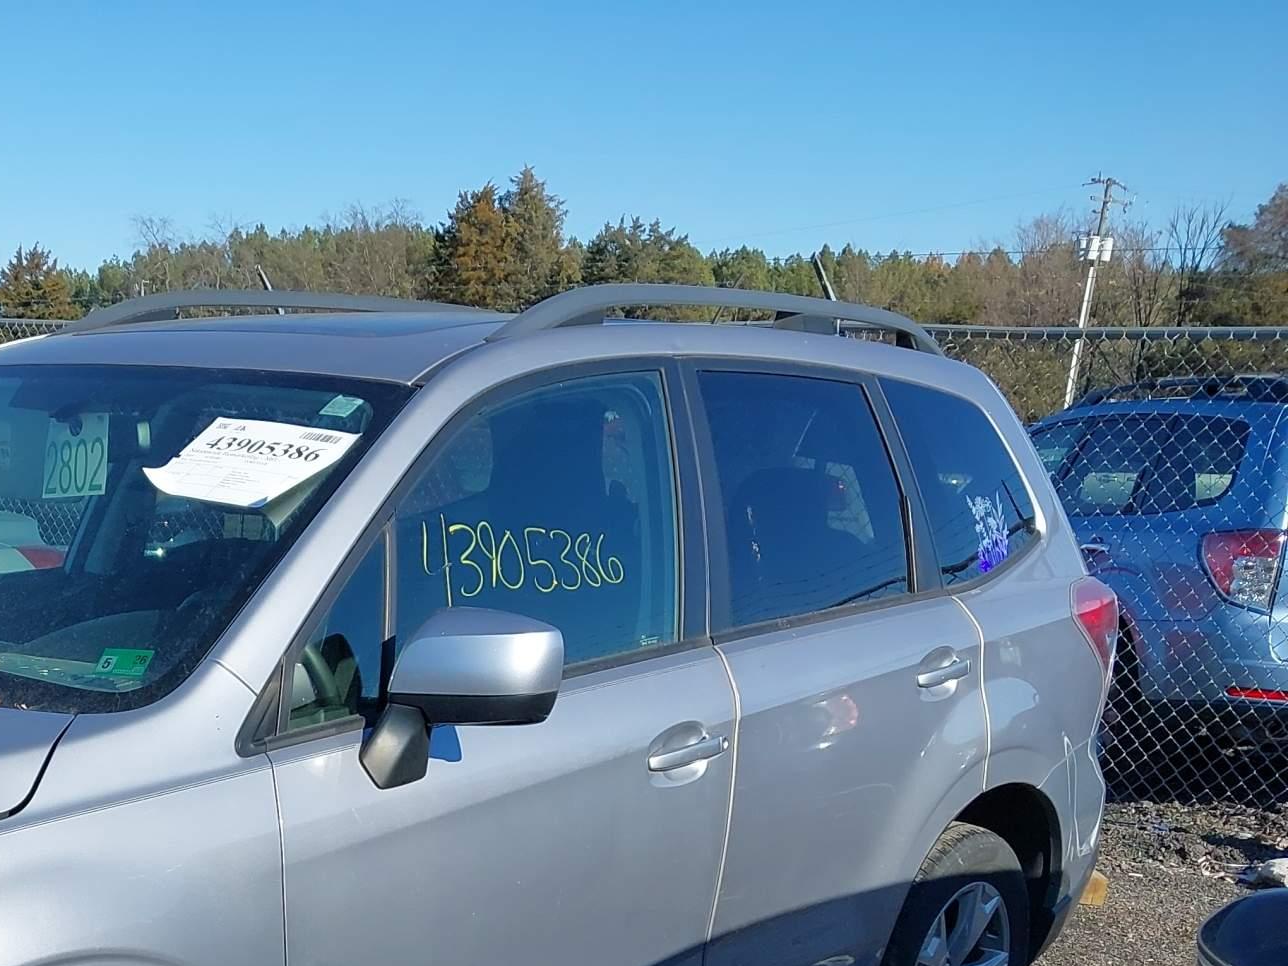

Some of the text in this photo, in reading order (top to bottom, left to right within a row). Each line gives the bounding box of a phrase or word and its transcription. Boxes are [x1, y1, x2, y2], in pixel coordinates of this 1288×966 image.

[45, 437, 105, 495] 2802
[206, 434, 329, 464] 43905386
[422, 512, 624, 609] 43905386
[101, 657, 113, 669] 5
